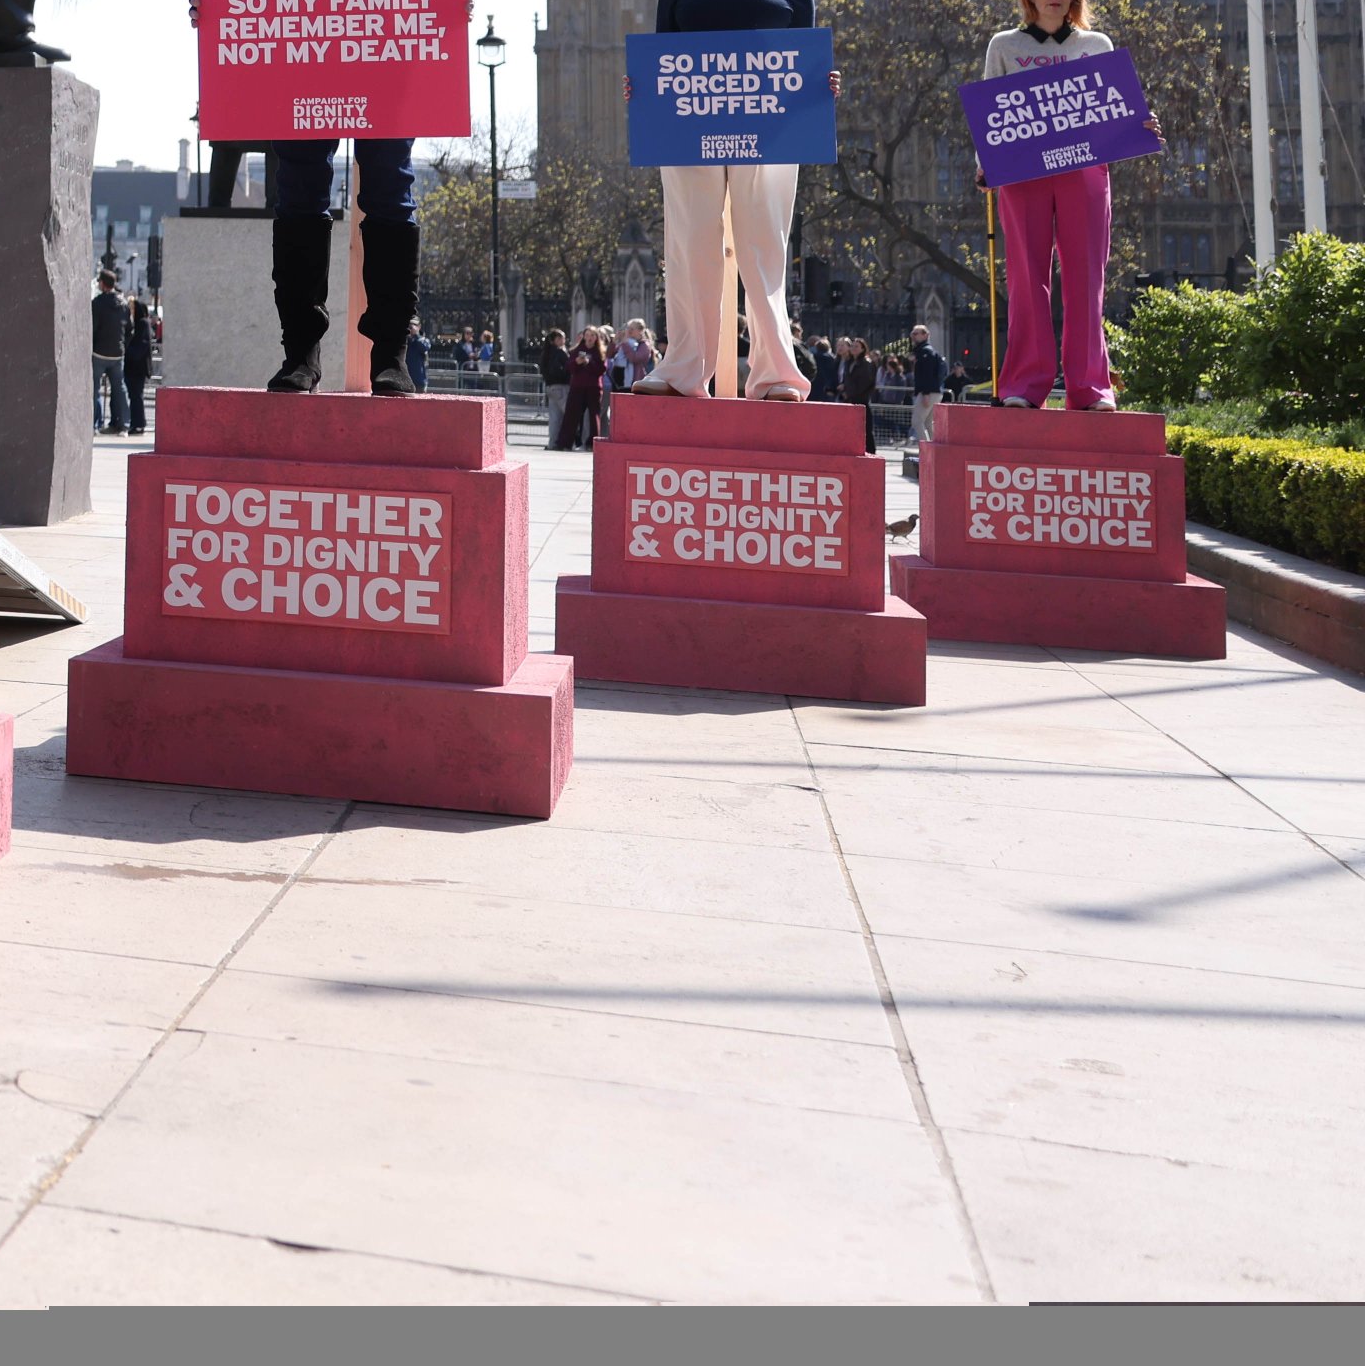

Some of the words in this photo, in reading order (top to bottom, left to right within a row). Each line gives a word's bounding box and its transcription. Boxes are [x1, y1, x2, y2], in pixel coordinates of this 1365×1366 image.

[220, 14, 384, 39] REMEMBER
[395, 13, 445, 38] ME,
[219, 42, 276, 65] NOT
[287, 40, 331, 63] MY
[341, 38, 448, 62] DEATH.
[659, 54, 693, 73] SO
[702, 53, 737, 72] I'M
[746, 51, 799, 70] NOT
[657, 74, 760, 94] FORCED
[768, 72, 803, 91] TO
[996, 91, 1026, 109] SO
[1029, 75, 1087, 101] THAT
[1094, 72, 1103, 87] I
[294, 97, 345, 105] CAMPAIGN
[294, 104, 367, 117] DIGNITY
[676, 95, 785, 115] SUFFER.
[987, 105, 1034, 128] CAN
[1038, 91, 1100, 118] HAVE
[1107, 87, 1123, 102] A
[294, 117, 311, 129] IN
[314, 117, 373, 129] DYING.
[986, 121, 1047, 146] GOOD
[1052, 101, 1135, 132] DEATH.
[702, 140, 758, 150] DIGNITY
[702, 150, 715, 159] IN
[718, 149, 763, 158] DYING.
[1043, 147, 1091, 162] DIGNITY
[1045, 161, 1057, 170] IN
[1059, 154, 1098, 168] DYING.
[629, 467, 843, 506] TOGETHER
[967, 465, 1151, 496] TOGETHER
[166, 484, 443, 538] TOGETHER
[632, 499, 694, 525] FOR
[706, 503, 842, 534] DIGNITY
[970, 491, 1024, 512] FOR
[1034, 494, 1150, 518] DIGNITY
[969, 513, 996, 539] &
[1007, 515, 1152, 547] CHOICE
[168, 528, 249, 563] FOR
[264, 534, 440, 576] DIGNITY
[629, 525, 661, 557] &
[674, 528, 842, 569] CHOICE
[164, 564, 205, 608] &
[222, 568, 440, 625] CHOICE
